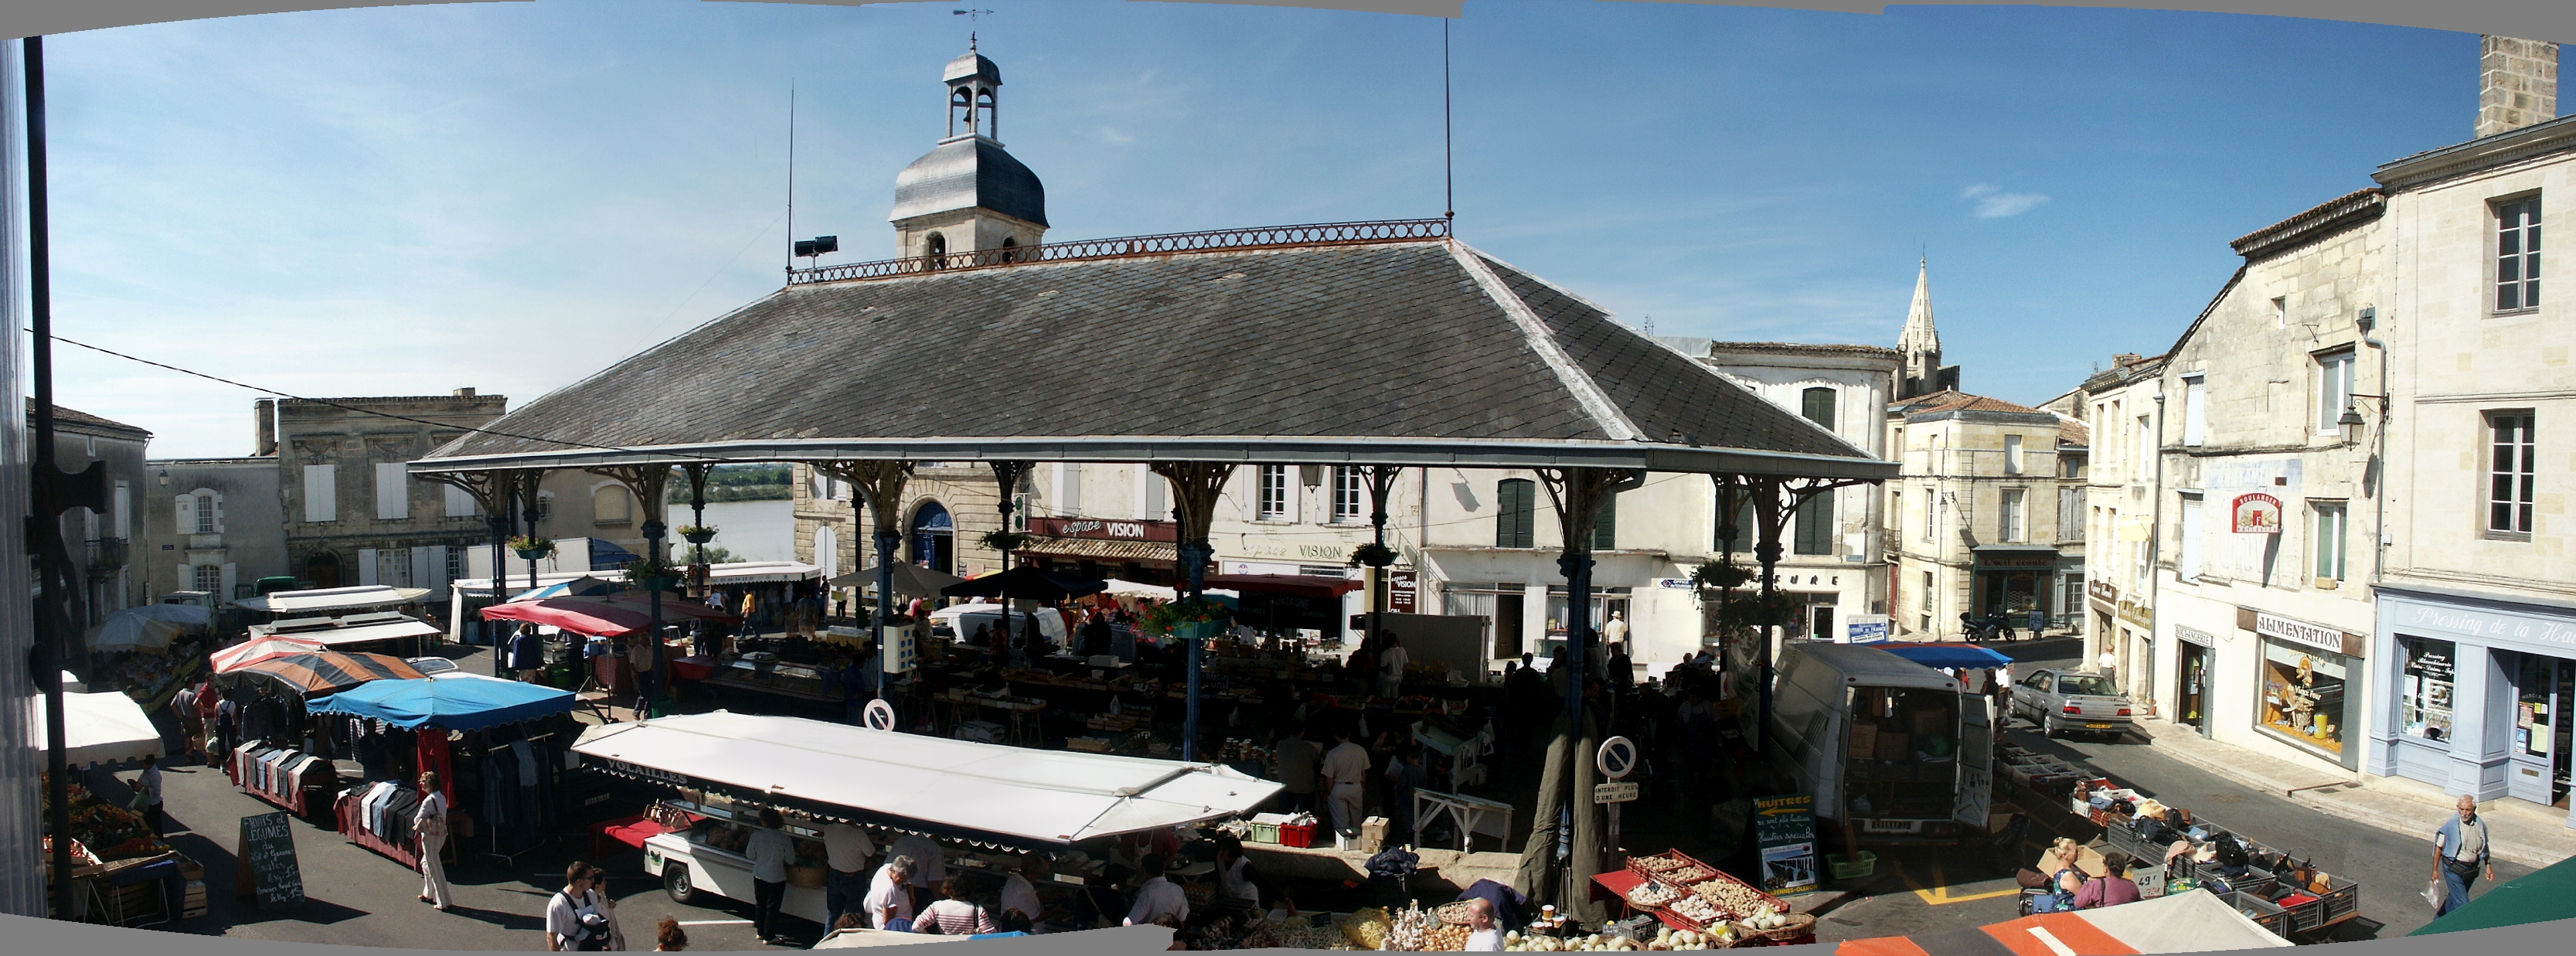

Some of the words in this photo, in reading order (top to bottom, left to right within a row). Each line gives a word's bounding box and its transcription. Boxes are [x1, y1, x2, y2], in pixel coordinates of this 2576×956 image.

[2239, 494, 2277, 505] BOULANGER
[1063, 520, 1102, 538] espace
[1106, 522, 1144, 537] VISION
[1299, 545, 1342, 558] VISION
[2412, 606, 2483, 636] Pressing
[2489, 619, 2506, 634] de
[2514, 621, 2530, 638] la
[2176, 626, 2210, 645] BOULANGERIE
[2258, 617, 2341, 648] ALIMENTATION
[607, 758, 688, 784] VOLAILLES
[1757, 795, 1812, 808] HUITRES
[243, 814, 273, 830] FRUITS
[246, 825, 290, 842] LEGUMES
[263, 842, 274, 850] du
[2139, 876, 2150, 886] 49
